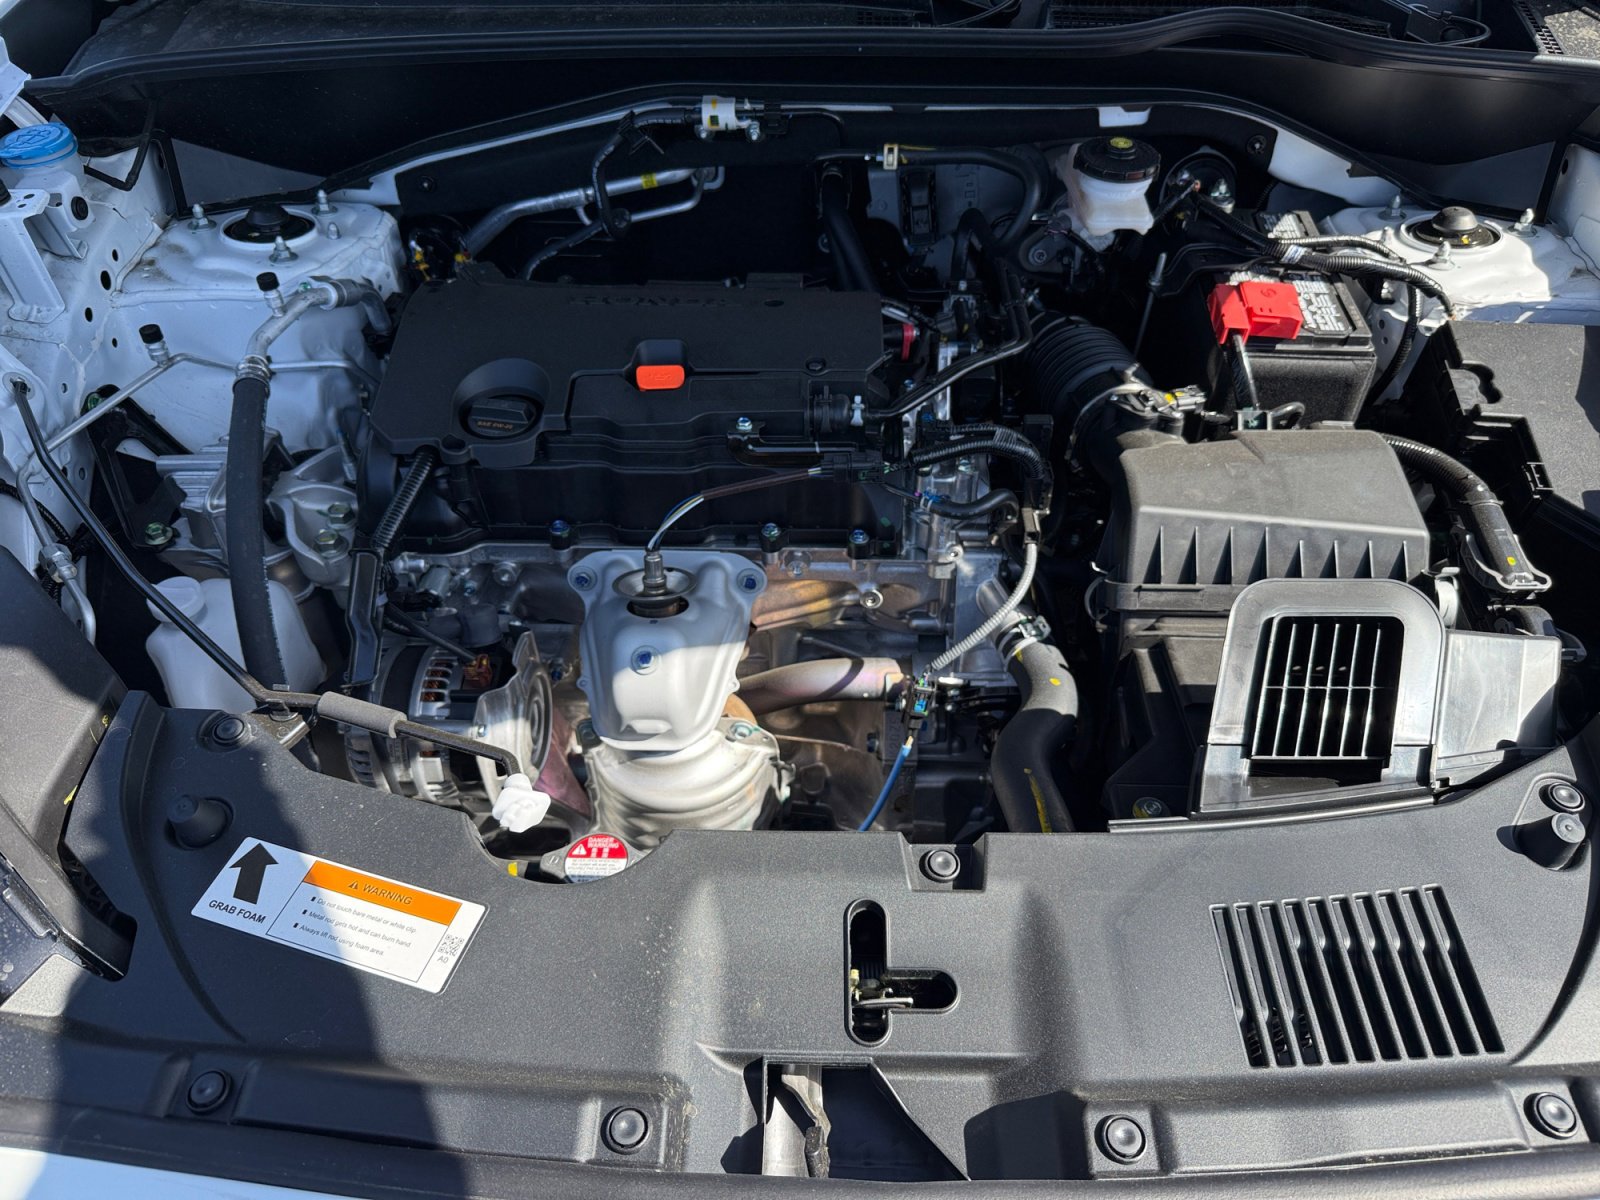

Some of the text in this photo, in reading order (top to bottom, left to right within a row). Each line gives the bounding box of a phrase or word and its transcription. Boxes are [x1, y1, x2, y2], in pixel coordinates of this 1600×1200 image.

[363, 883, 413, 905] WARNING
[208, 900, 267, 924] GRAB FOAM
[317, 898, 327, 906] Do
[327, 901, 337, 909] not
[336, 902, 352, 914] touch
[352, 907, 366, 918] bare
[366, 912, 382, 923] metal
[390, 920, 406, 931] white
[405, 924, 416, 934] clip
[299, 924, 320, 937] Always
[327, 933, 339, 943] rod
[338, 936, 354, 949] using
[354, 939, 371, 951] foam
[308, 910, 325, 921] Metal
[324, 915, 336, 925] rod
[334, 920, 348, 930] gets
[348, 923, 358, 932] hot
[358, 926, 370, 936] and
[381, 933, 396, 943] burn
[395, 938, 412, 948] hand
[437, 955, 449, 964] A0
